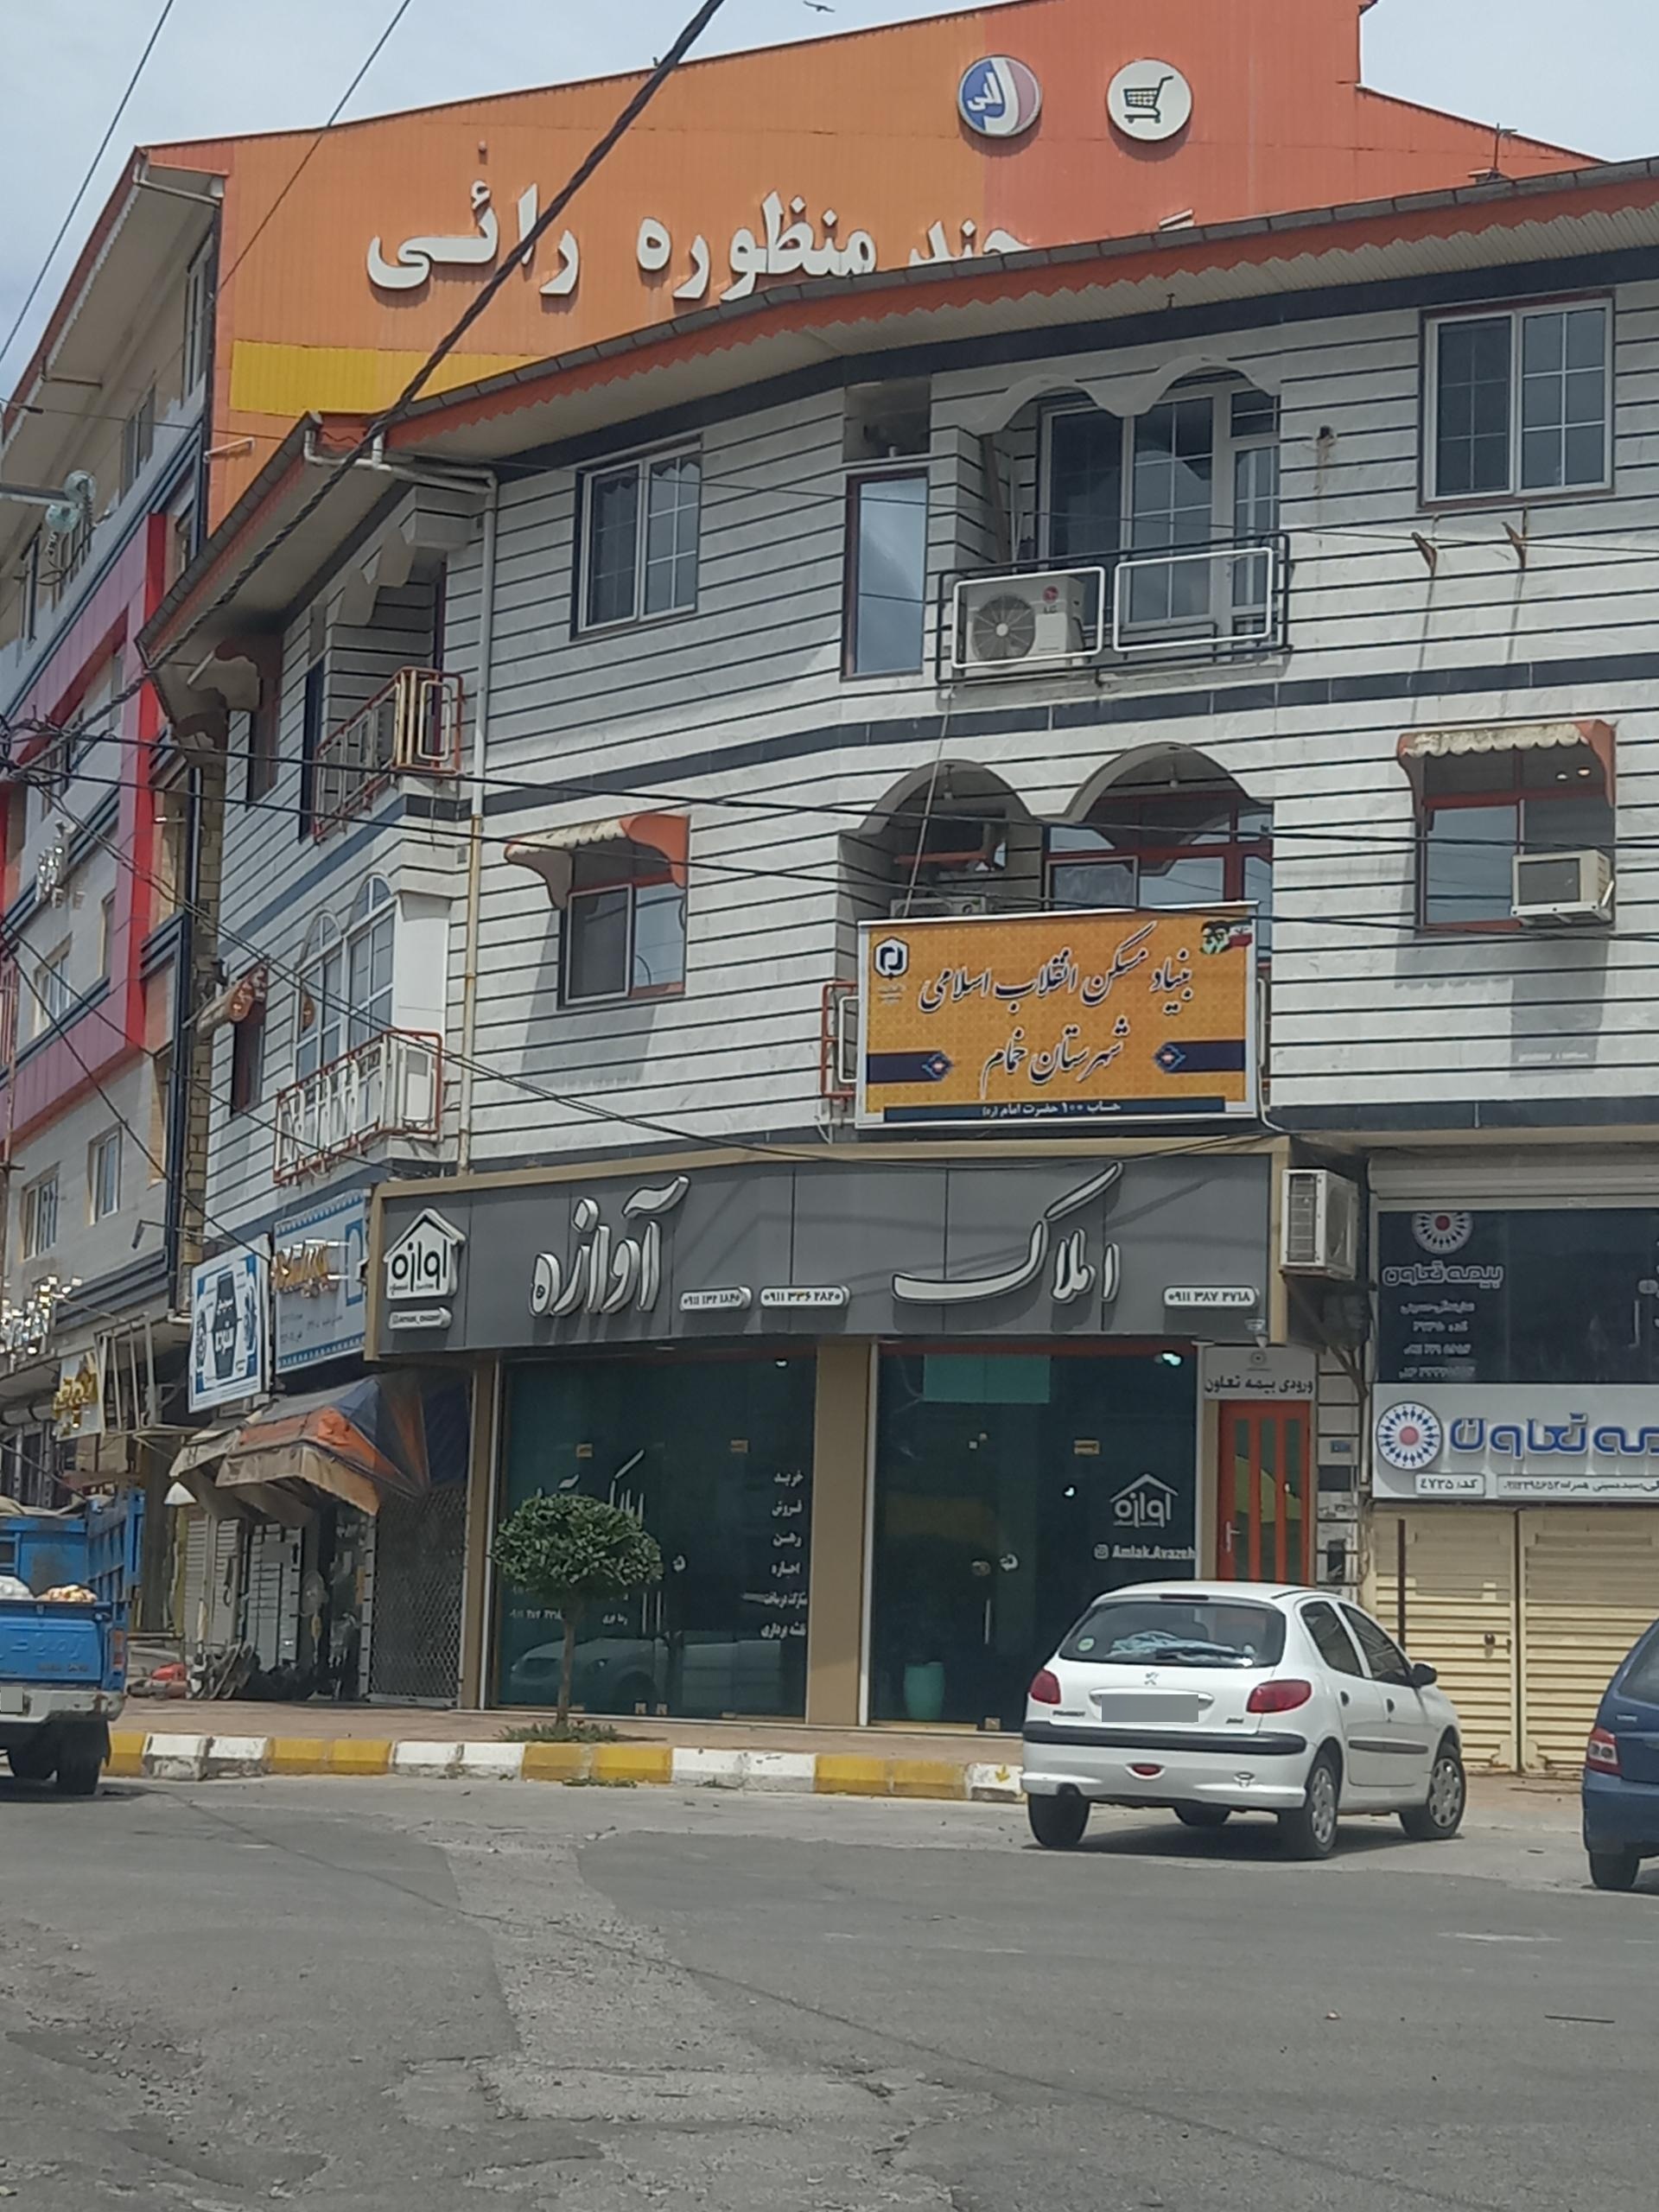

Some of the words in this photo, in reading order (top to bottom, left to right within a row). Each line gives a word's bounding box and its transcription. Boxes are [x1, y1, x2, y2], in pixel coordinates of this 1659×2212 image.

[366, 180, 580, 296] رائی
[637, 190, 876, 301] منظوره
[918, 965, 992, 1013] اسلامی
[994, 947, 1079, 1014] انقلاب
[1080, 920, 1158, 1006] مسکن
[1150, 948, 1193, 1014] بنیاد
[980, 1027, 1028, 1101] خمام
[1029, 1015, 1129, 1085] شهرستان
[1087, 1101, 1122, 1113] حساب
[530, 1175, 690, 1317] آوازه
[892, 1162, 1122, 1303] املاک
[1382, 1260, 1446, 1287] تعاون
[1446, 1265, 1504, 1289] بیمه
[1205, 1375, 1241, 1394] تعاون
[1244, 1379, 1276, 1395] بیمه
[1279, 1379, 1313, 1395] ورودی
[1449, 1411, 1588, 1462] تعاون
